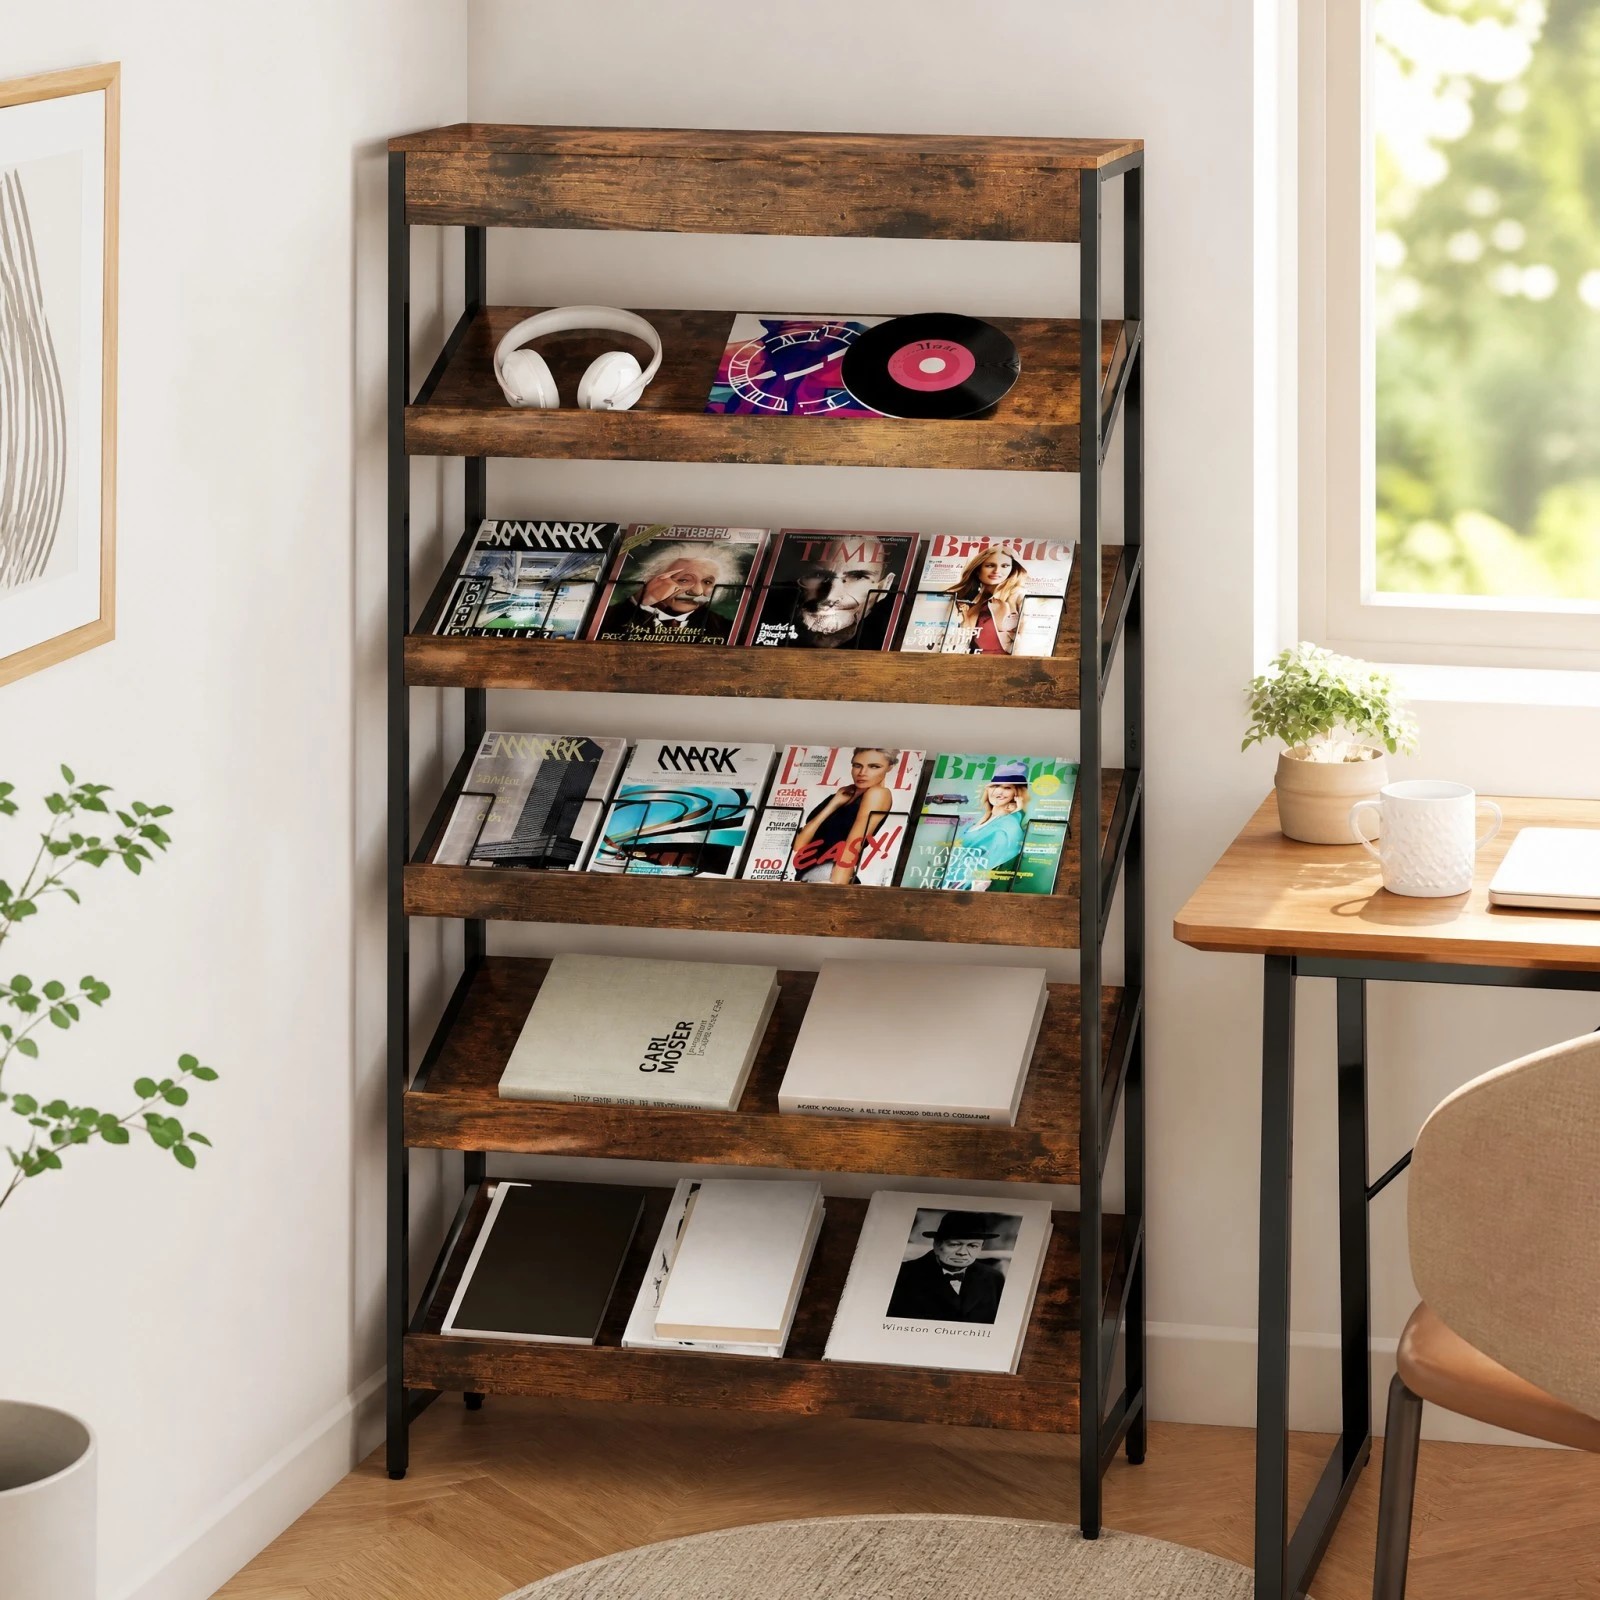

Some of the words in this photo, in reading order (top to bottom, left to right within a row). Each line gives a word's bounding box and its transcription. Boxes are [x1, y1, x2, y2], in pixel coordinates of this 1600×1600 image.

[796, 540, 898, 564] TIME
[931, 534, 1071, 562] Briitte
[657, 745, 742, 774] MARK
[792, 825, 903, 871] EASY!
[753, 857, 783, 870] 100
[638, 1033, 671, 1073] CARL
[657, 1021, 695, 1074] MOSER
[881, 1322, 930, 1334] Winston
[934, 1326, 992, 1339] Churchill
